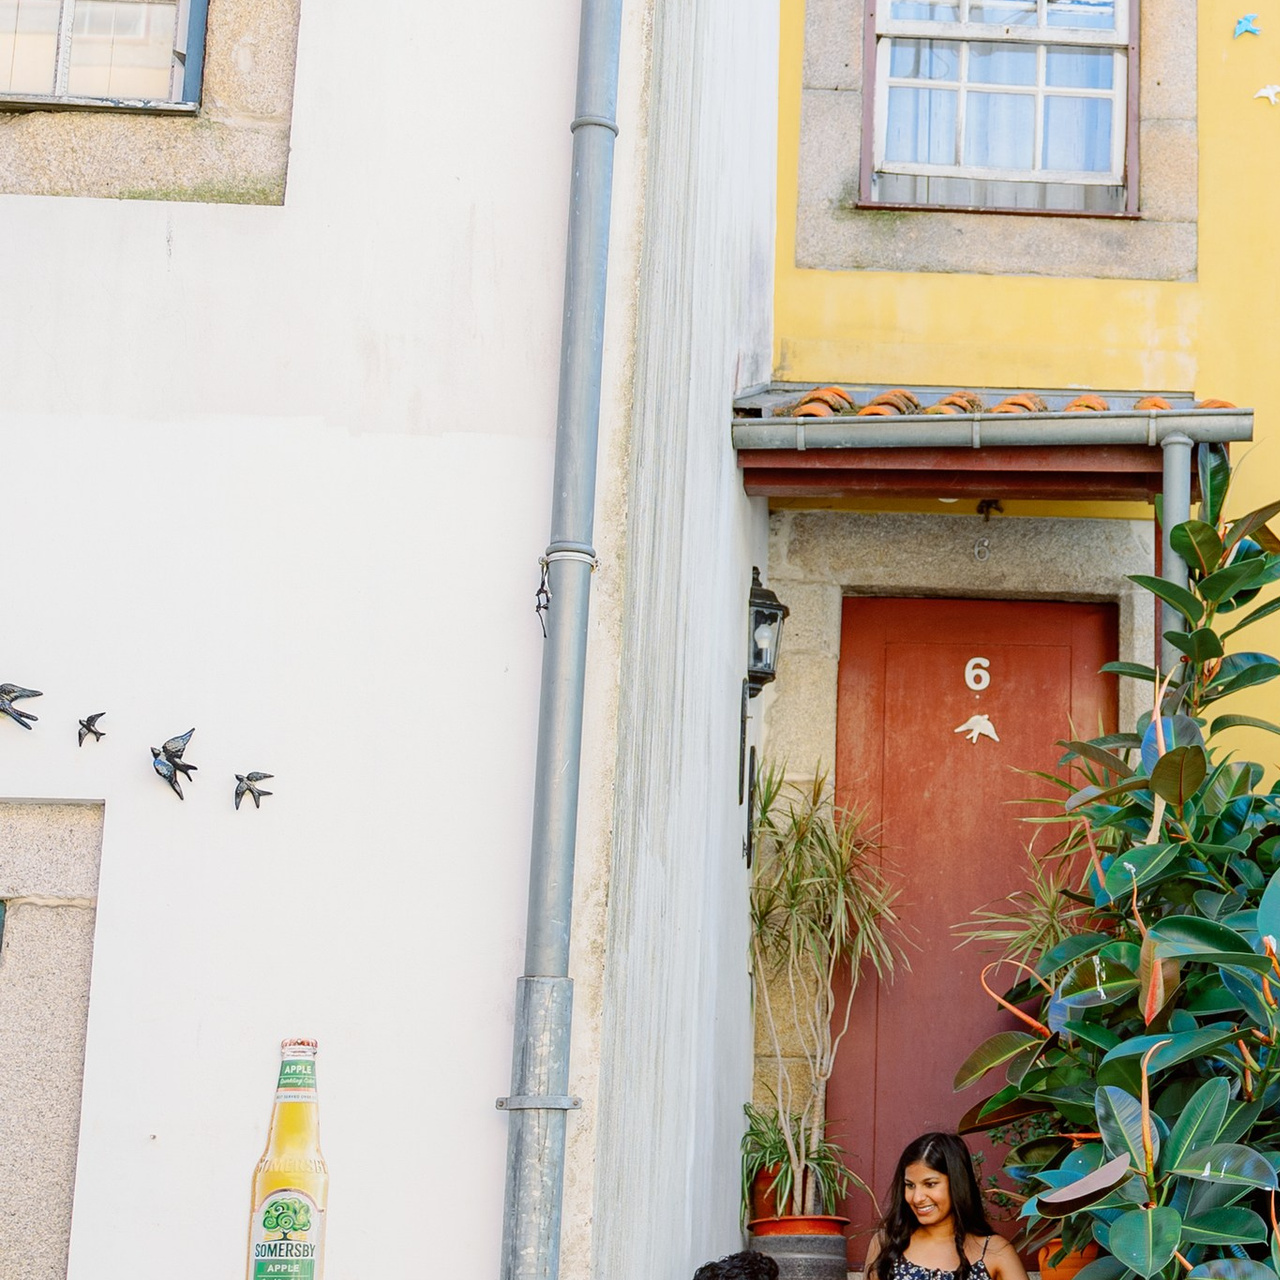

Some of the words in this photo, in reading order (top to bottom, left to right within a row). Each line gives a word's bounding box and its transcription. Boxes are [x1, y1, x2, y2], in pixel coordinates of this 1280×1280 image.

[974, 537, 990, 561] 6
[964, 657, 991, 691] 6
[284, 1065, 312, 1074] APPLE
[255, 1243, 316, 1258] SOMERSBY
[267, 1264, 300, 1272] APPLE
